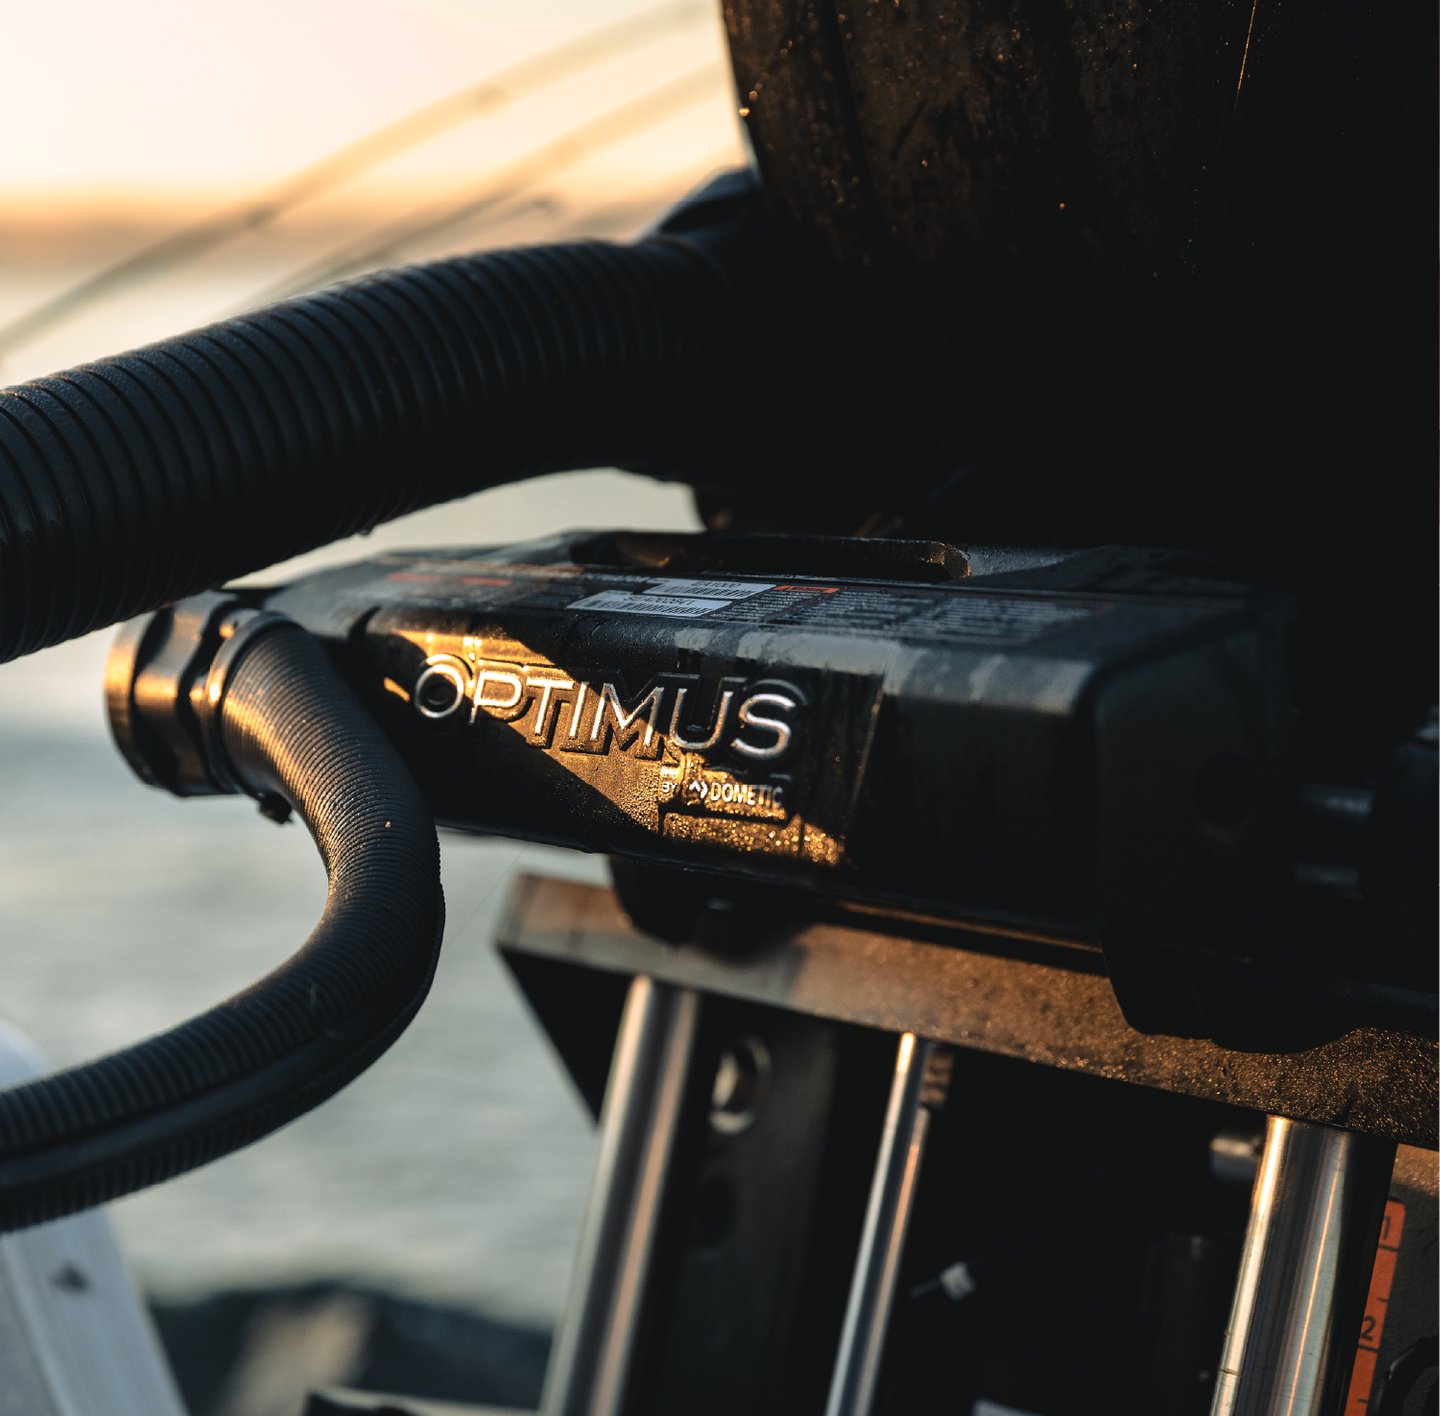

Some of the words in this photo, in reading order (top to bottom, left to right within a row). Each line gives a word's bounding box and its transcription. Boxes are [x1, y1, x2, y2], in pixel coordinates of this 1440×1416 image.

[413, 663, 797, 760] OPTIMUS
[710, 782, 783, 808] DOMETIC
[1360, 1315, 1376, 1342] 2
